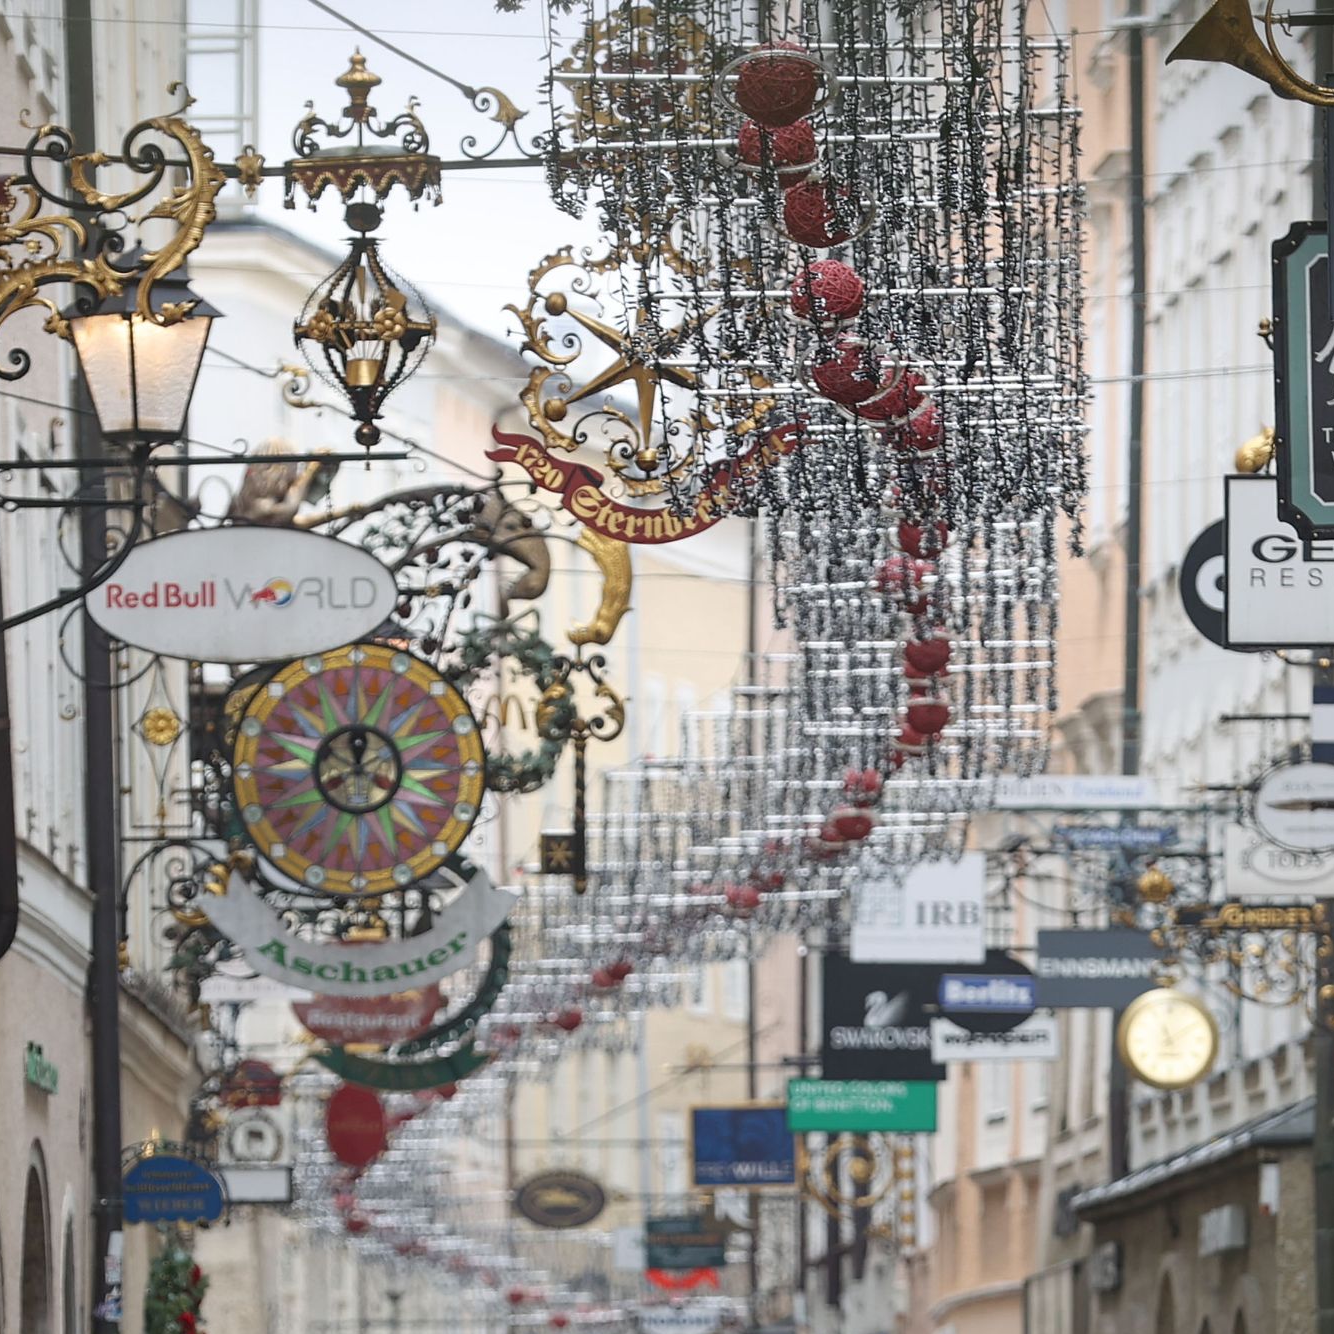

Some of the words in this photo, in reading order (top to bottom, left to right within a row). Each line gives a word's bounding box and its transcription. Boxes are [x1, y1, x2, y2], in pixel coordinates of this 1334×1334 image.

[514, 443, 565, 490] 1720
[256, 931, 469, 983] Aschauer
[830, 1026, 931, 1049] SWAROVSK
